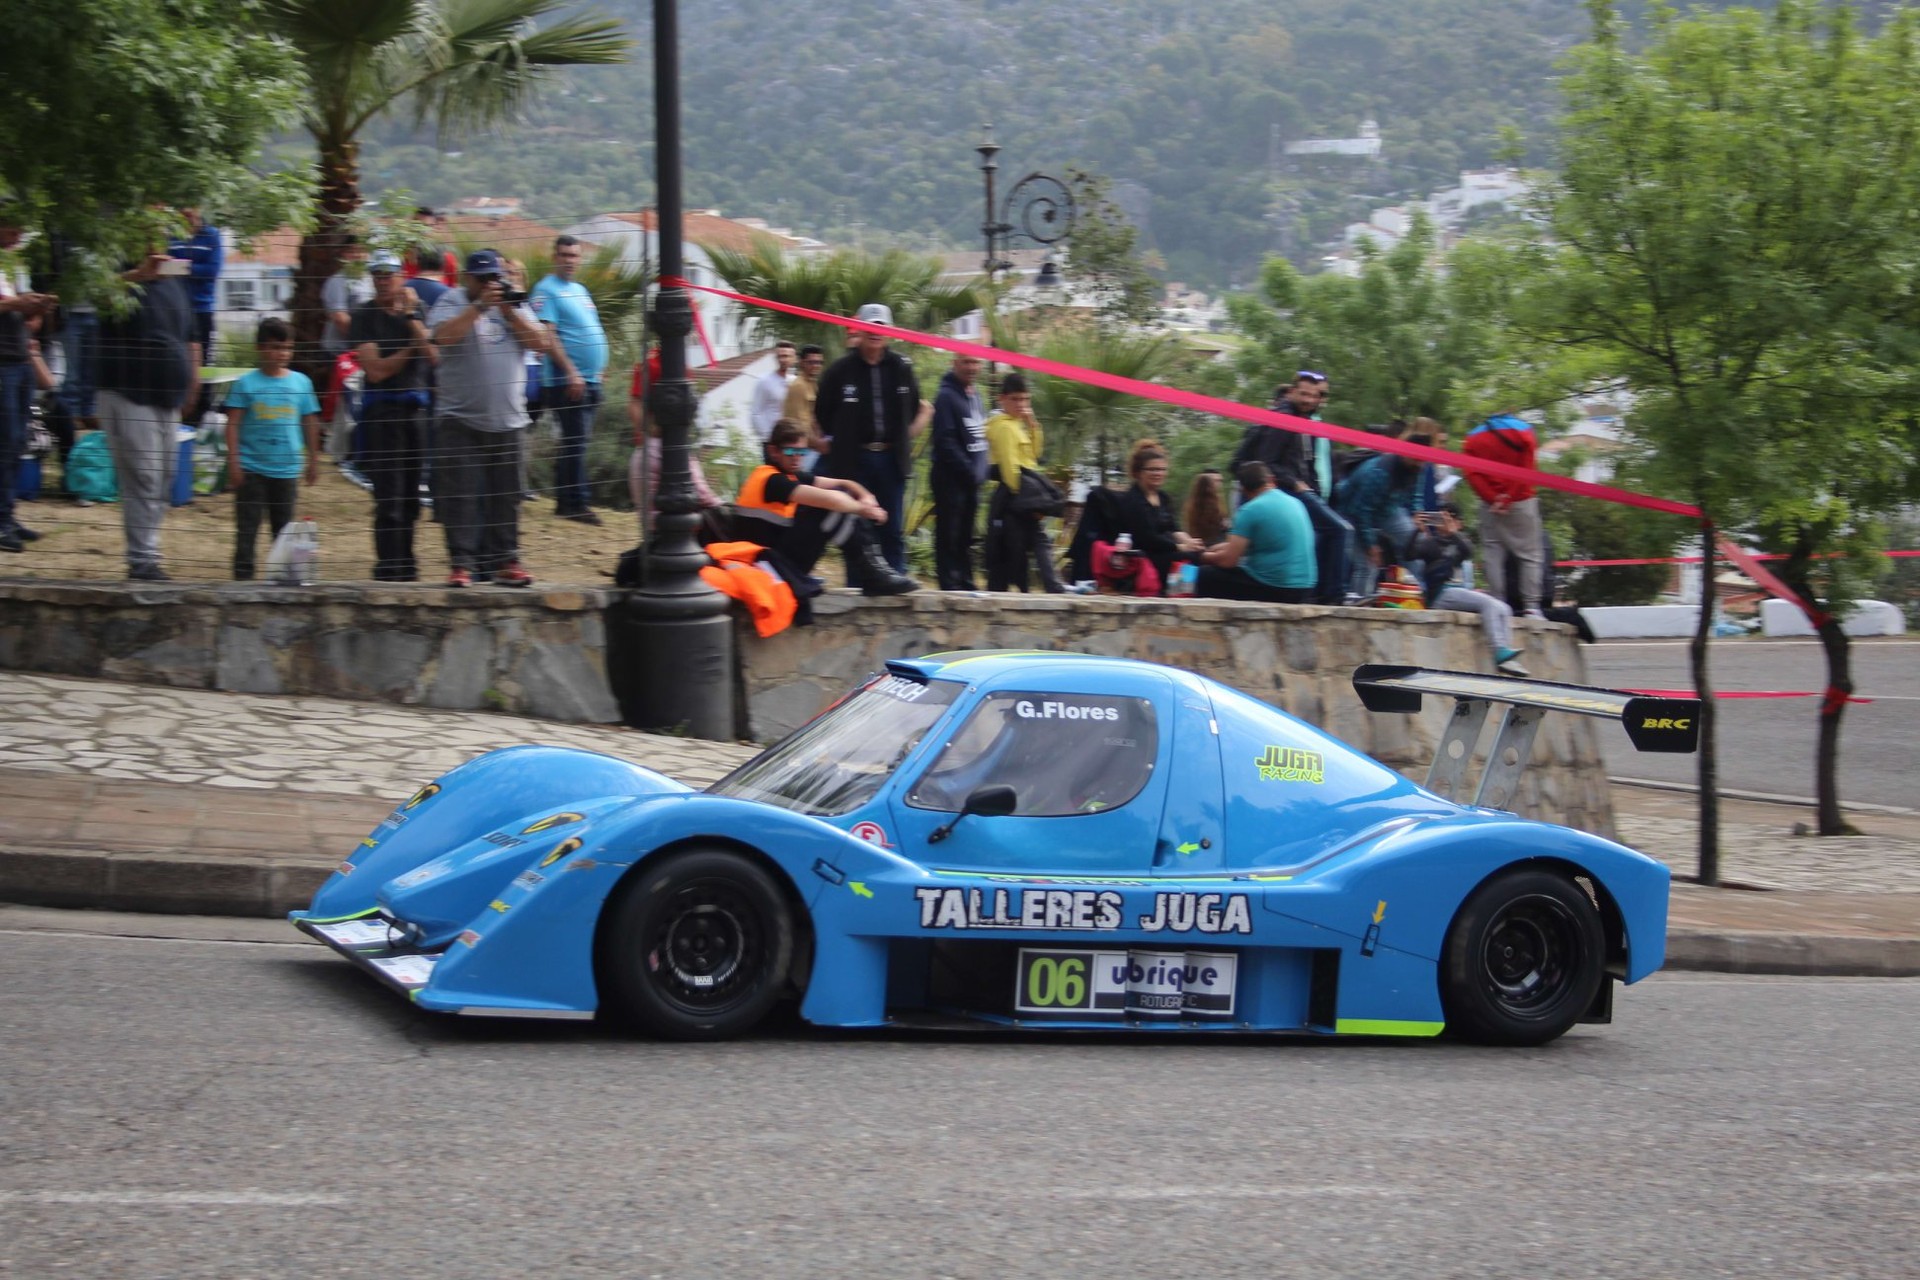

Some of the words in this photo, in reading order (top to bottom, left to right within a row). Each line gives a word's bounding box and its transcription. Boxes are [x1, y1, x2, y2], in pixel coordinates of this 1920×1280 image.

[1015, 700, 1119, 721] G.Flores
[1641, 718, 1691, 729] BRC
[1255, 745, 1323, 772] JUGA
[1259, 766, 1324, 784] RACING
[915, 887, 1123, 929] TALLERES
[1139, 891, 1252, 933] JUGA
[1028, 957, 1085, 1006] 06
[1112, 957, 1218, 992] ubrique
